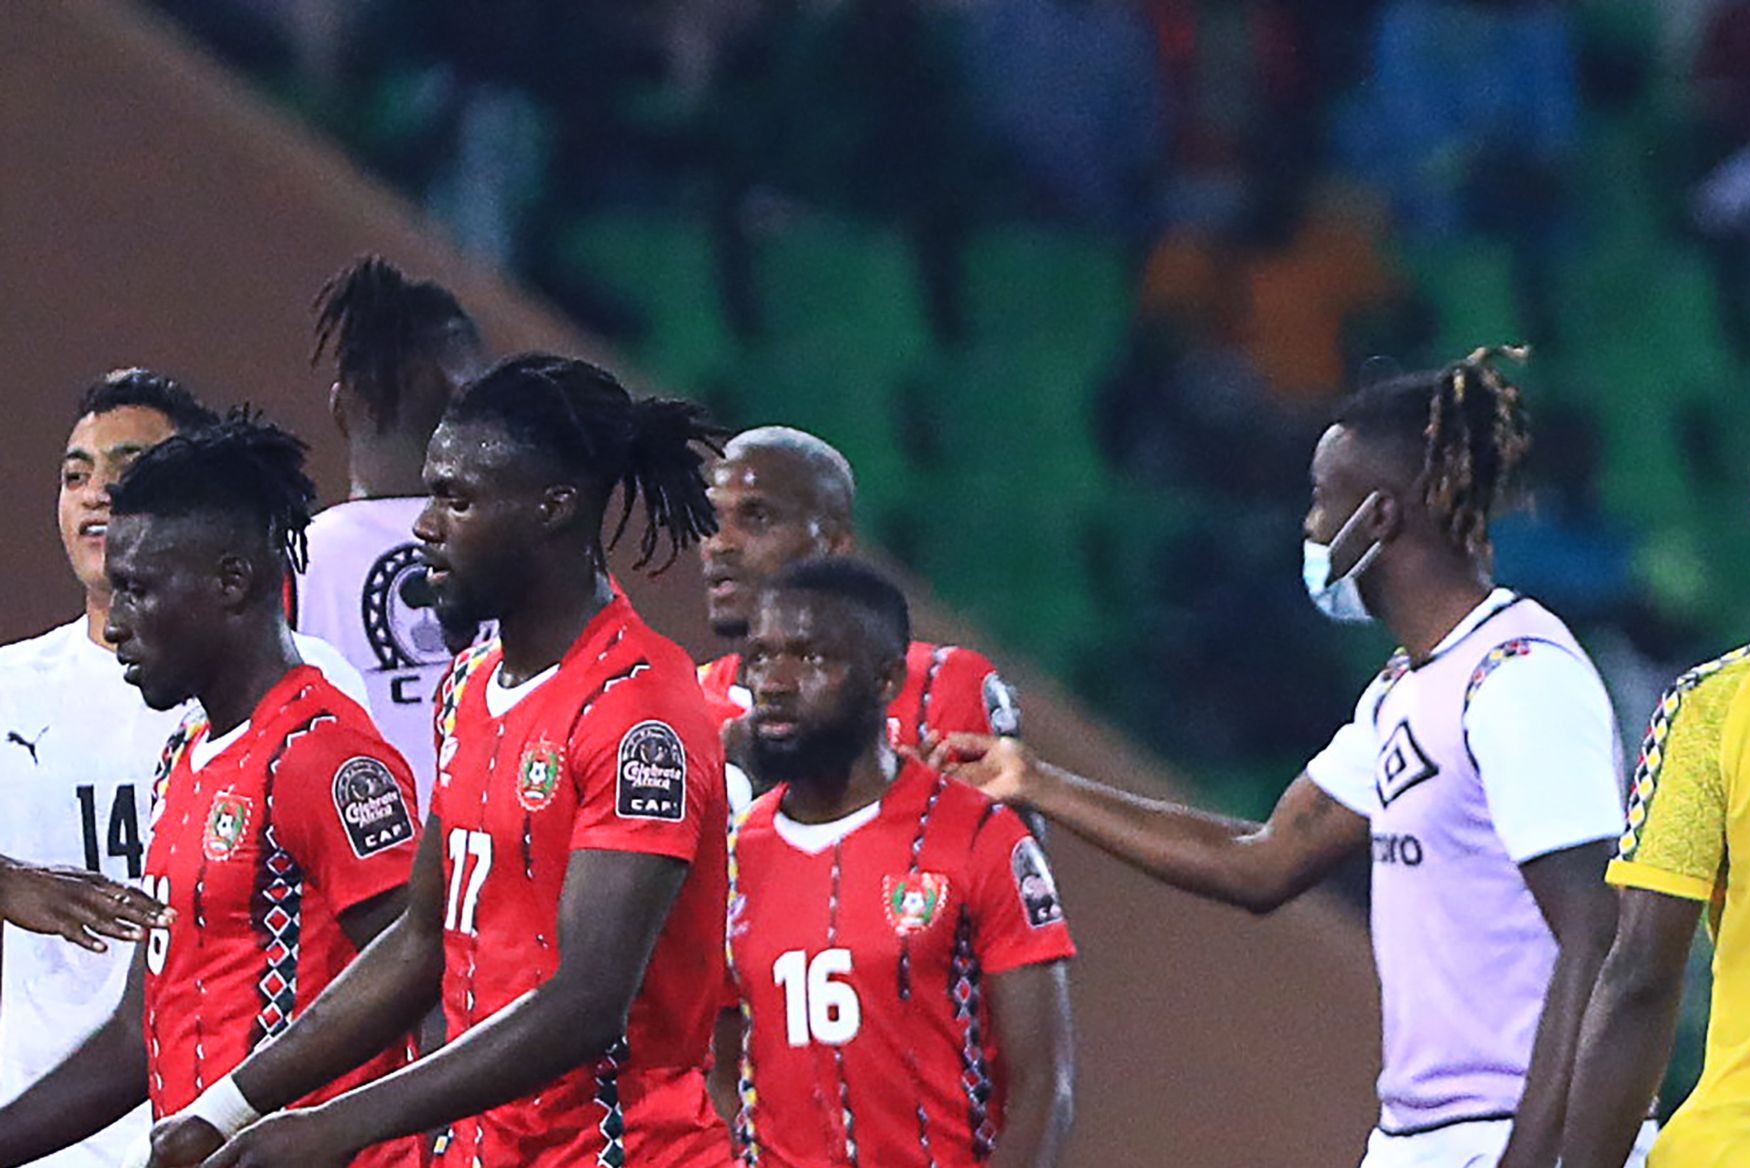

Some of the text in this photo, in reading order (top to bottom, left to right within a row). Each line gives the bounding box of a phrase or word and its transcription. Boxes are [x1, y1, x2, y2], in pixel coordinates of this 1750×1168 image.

[76, 784, 144, 879] 14
[443, 827, 493, 937] 17
[773, 948, 860, 1048] 16
